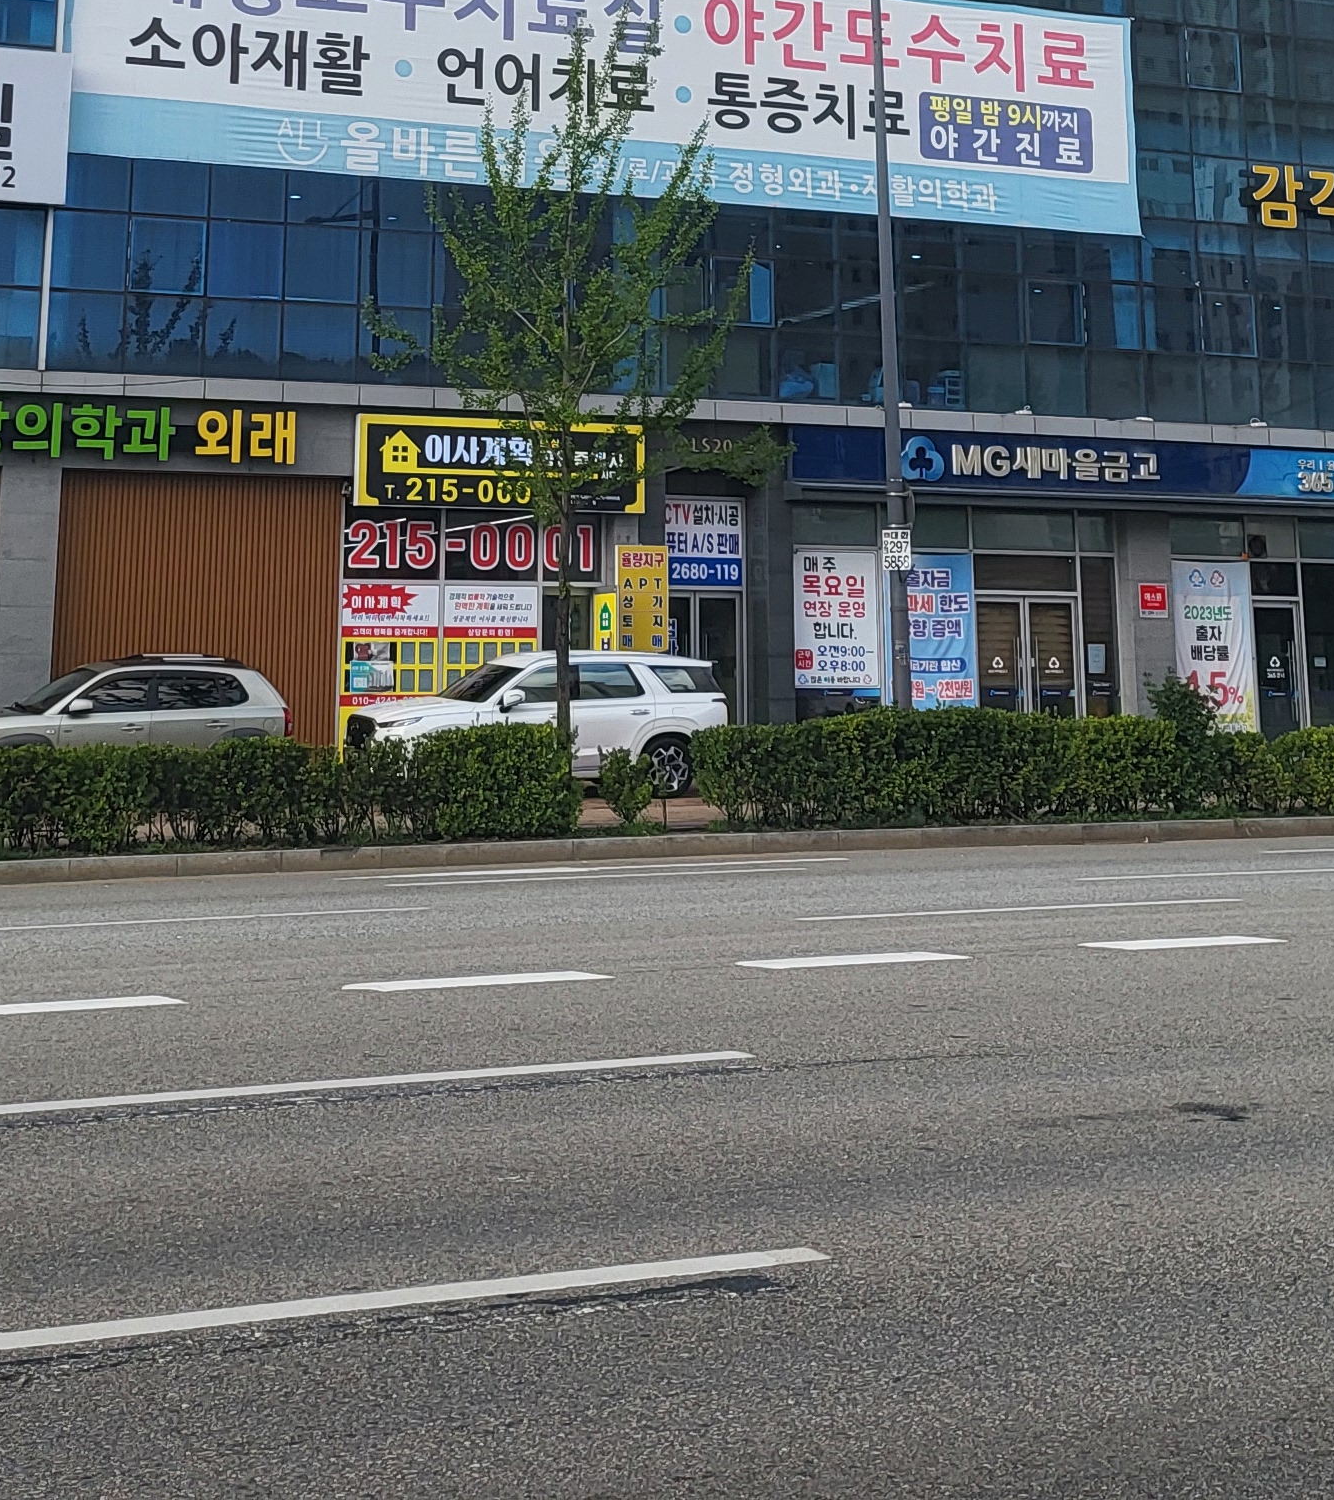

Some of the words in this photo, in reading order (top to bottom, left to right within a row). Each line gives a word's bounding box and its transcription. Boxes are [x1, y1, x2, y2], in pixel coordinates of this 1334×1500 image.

[125, 17, 370, 96] 소아재활
[437, 48, 656, 115] 언어치료
[707, 71, 911, 140] 통증치료
[930, 95, 973, 126] 평일
[980, 100, 1002, 128] 밤
[1008, 103, 1079, 136] 9시까지
[930, 124, 1084, 168] 야간진료
[194, 409, 297, 465] 외래
[424, 434, 533, 467] 이사계획
[951, 443, 1161, 483] MG새마을금고
[1297, 459, 1315, 471] 우리
[348, 519, 594, 573] 215-0001
[692, 533, 714, 553] A/S
[717, 533, 739, 555] 판매
[672, 563, 739, 581] 2680-119
[803, 556, 836, 573] 매주
[803, 575, 865, 598] 목요일
[351, 595, 402, 609] 이사계획
[803, 601, 832, 618] 연장
[838, 601, 866, 618] 운영
[939, 594, 969, 613] 한도
[1184, 605, 1233, 621] 2023년도
[813, 622, 857, 640] 합니다.
[932, 619, 962, 638] 증액
[1196, 625, 1222, 642] 출자
[1191, 645, 1230, 662] 배당률
[798, 659, 812, 668] 시간
[817, 660, 866, 673] 오후8:00
[939, 680, 973, 699] 2천만원
